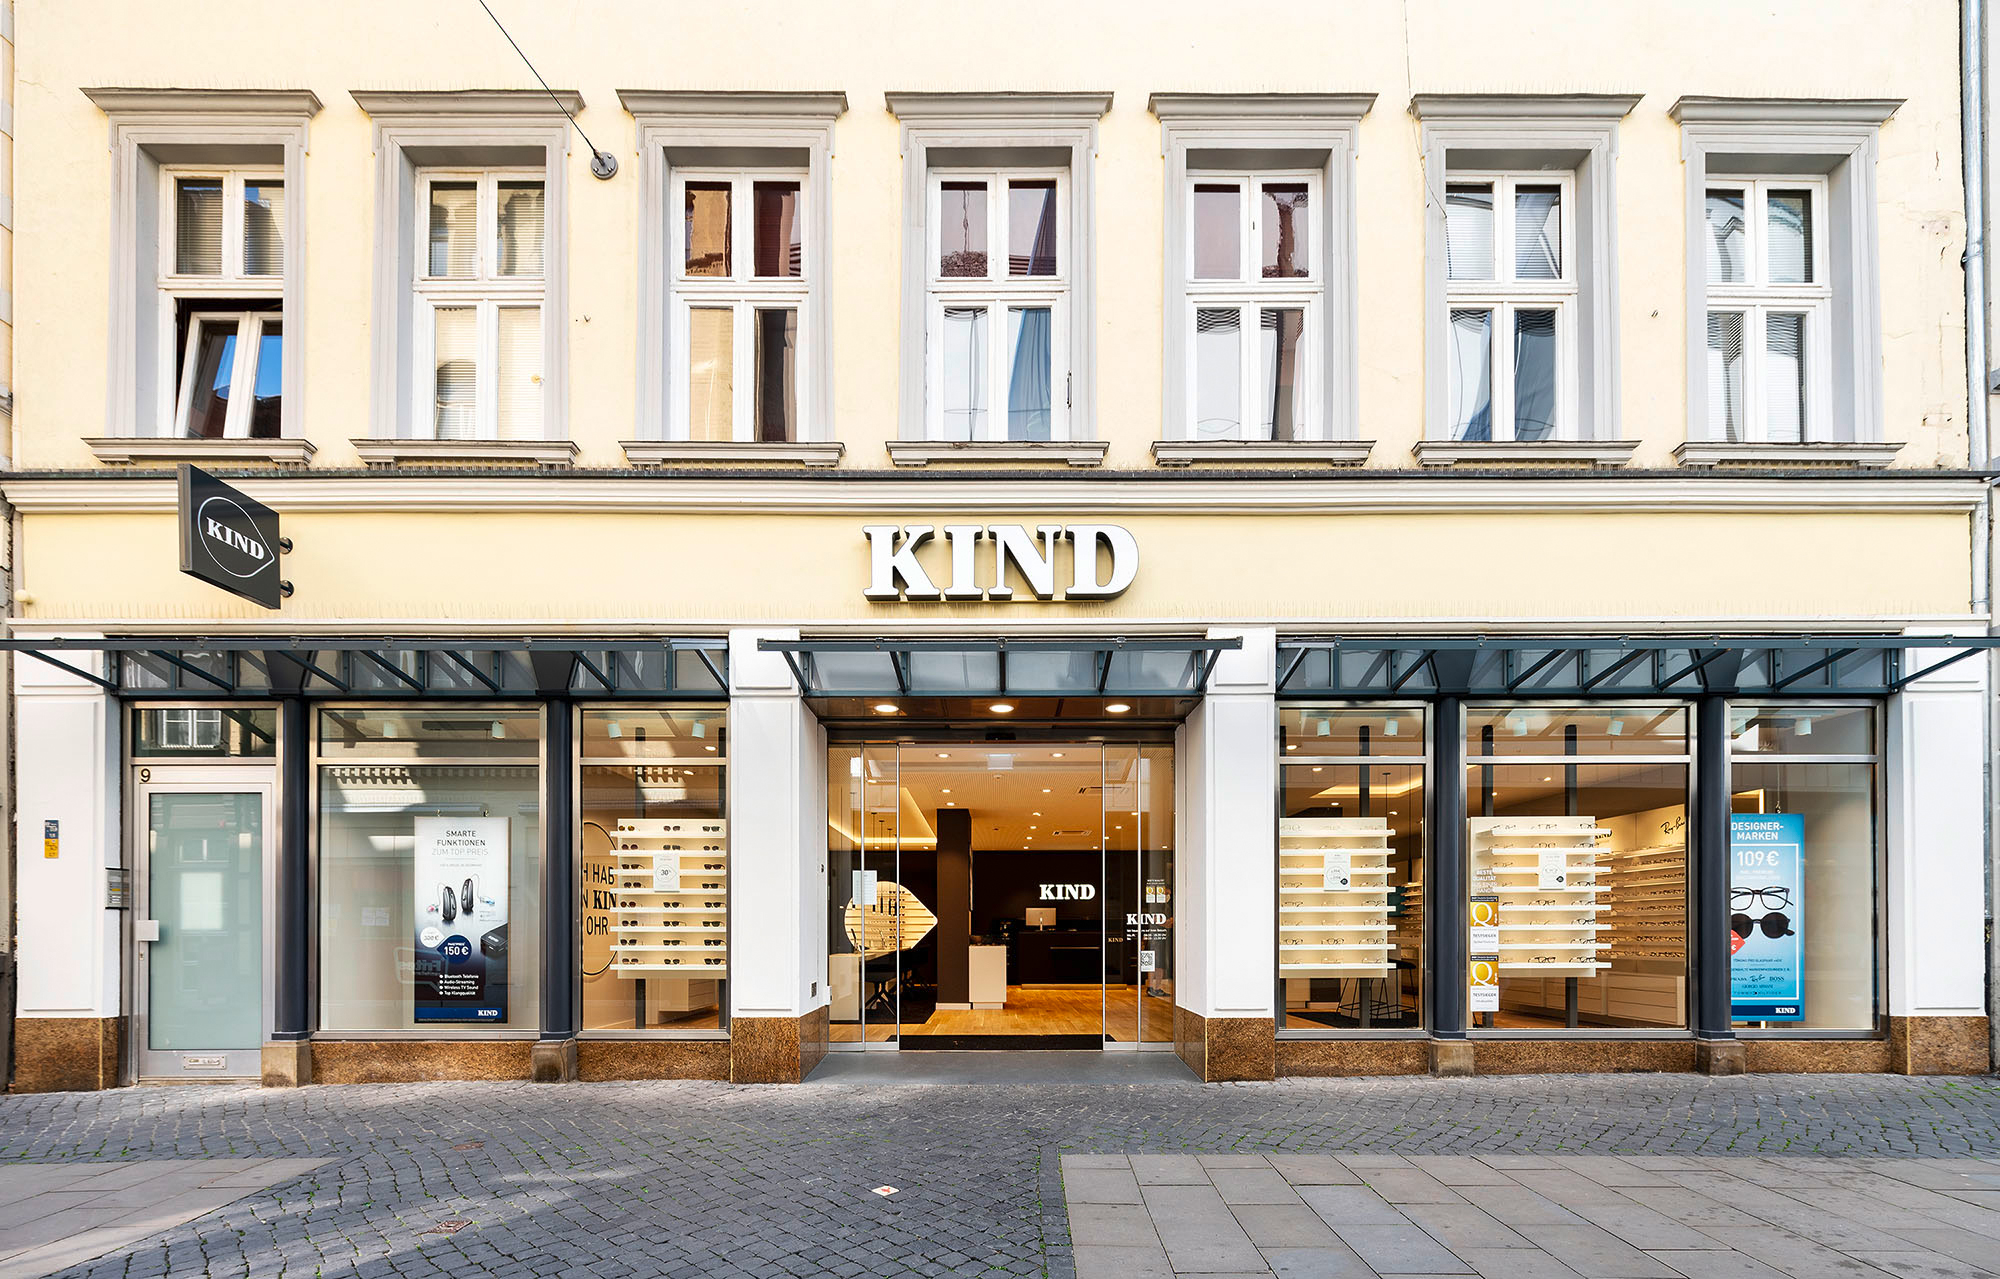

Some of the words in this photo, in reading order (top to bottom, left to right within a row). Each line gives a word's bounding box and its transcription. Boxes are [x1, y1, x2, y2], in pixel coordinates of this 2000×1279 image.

[206, 516, 265, 560] KIND
[862, 524, 1140, 599] KIND
[140, 768, 151, 782] 9
[1731, 821, 1784, 831] DESIGNER-
[1736, 831, 1778, 840] MARKEN
[1736, 850, 1765, 867] 109
[1766, 850, 1780, 867] €
[1039, 884, 1096, 900] KIND
[586, 915, 609, 936] OHR
[1126, 913, 1167, 925] KIND
[444, 946, 461, 955] 150
[461, 946, 469, 955] €
